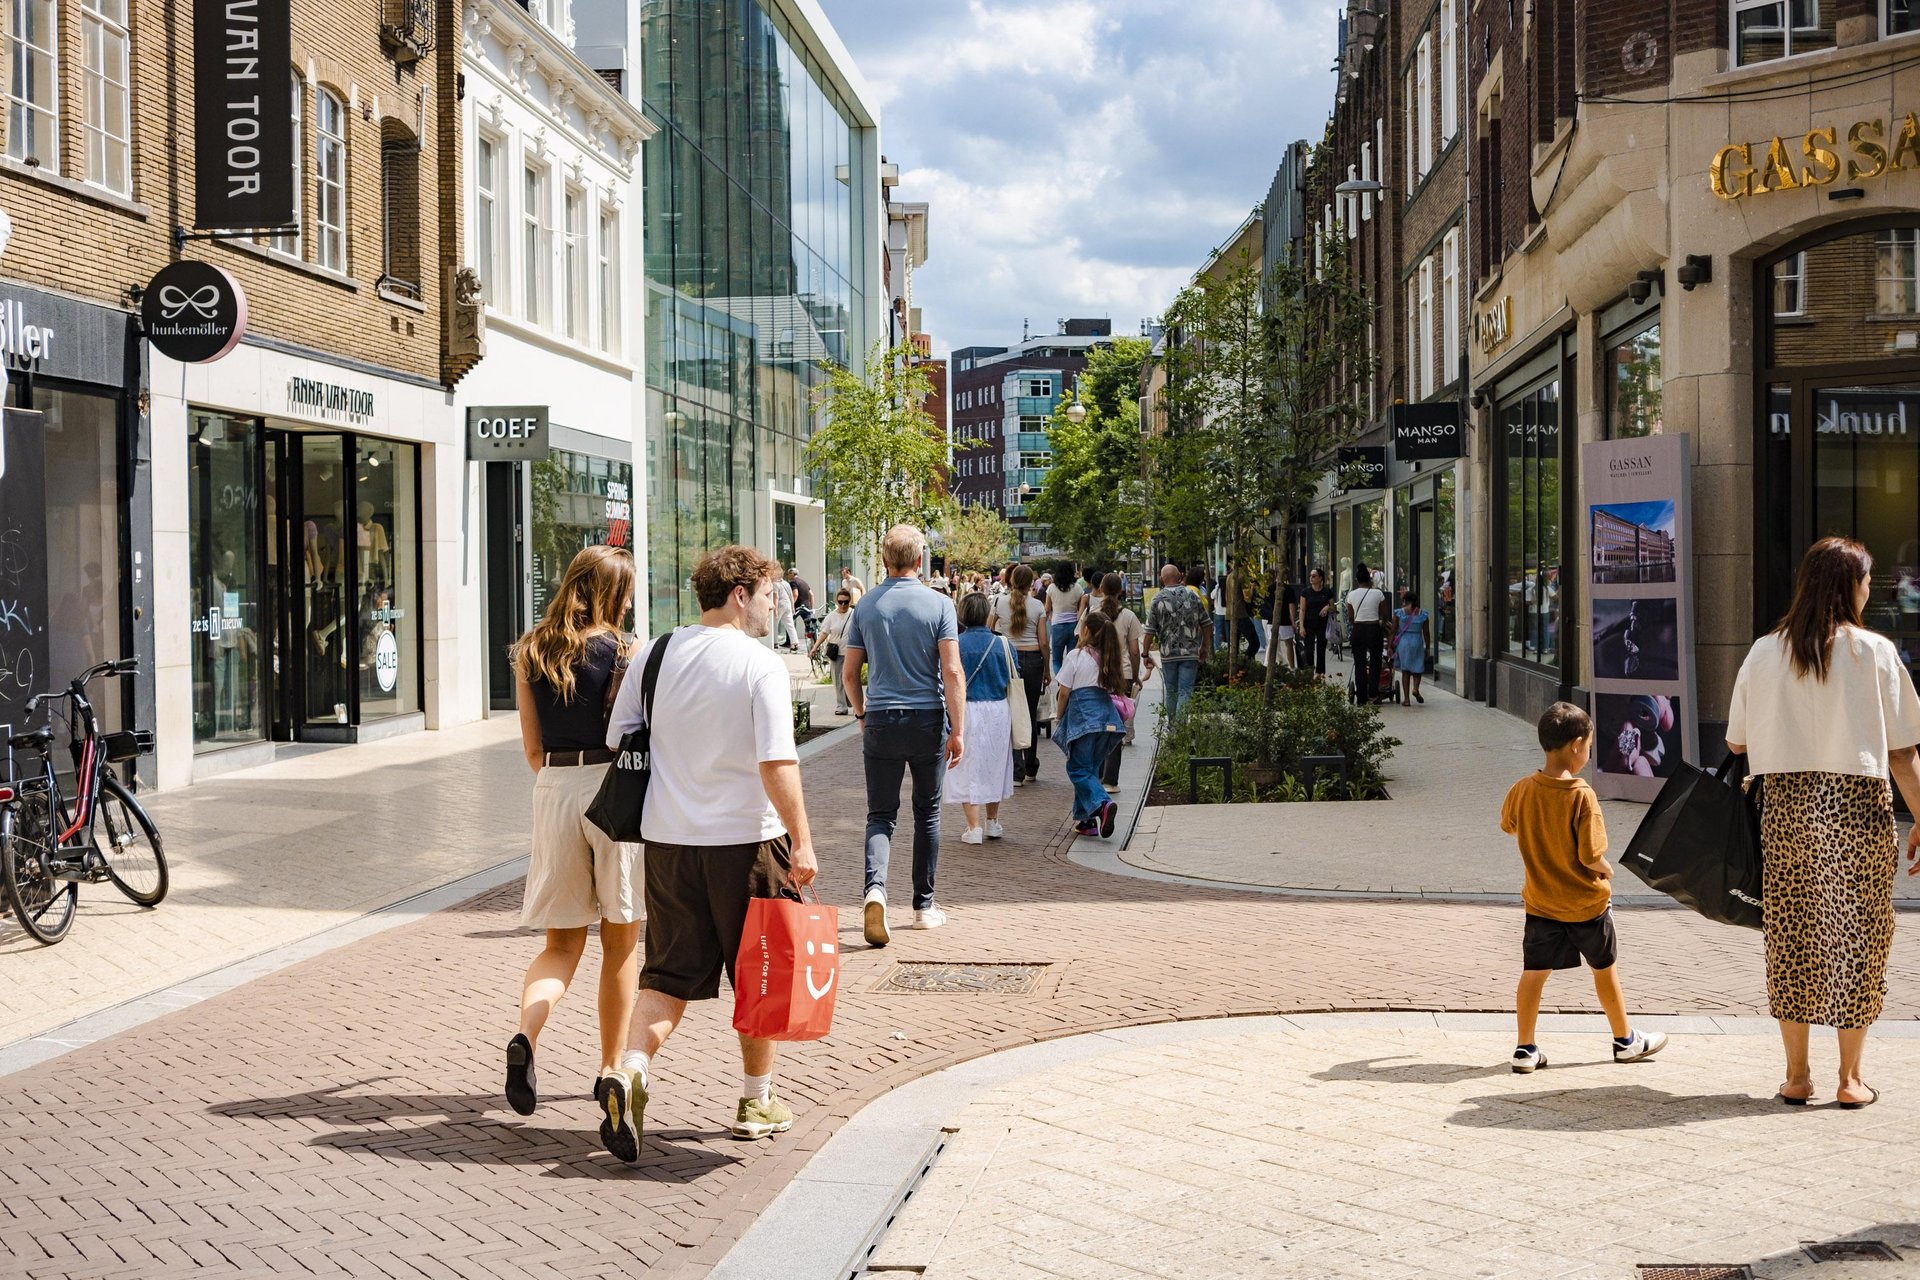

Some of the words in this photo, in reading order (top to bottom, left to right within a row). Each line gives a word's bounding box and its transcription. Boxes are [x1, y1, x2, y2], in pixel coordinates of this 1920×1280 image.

[226, 0, 258, 79] VAN
[227, 96, 260, 198] TOOR
[151, 322, 228, 335] hunkemöller
[293, 376, 323, 407] ANNA
[325, 383, 348, 411] VAN
[349, 388, 375, 417] TOOR
[477, 417, 537, 438] COEF
[1398, 425, 1456, 438] MANGO
[1610, 456, 1651, 470] GASSAN
[607, 481, 628, 501] SPRING
[377, 652, 396, 669] SALE
